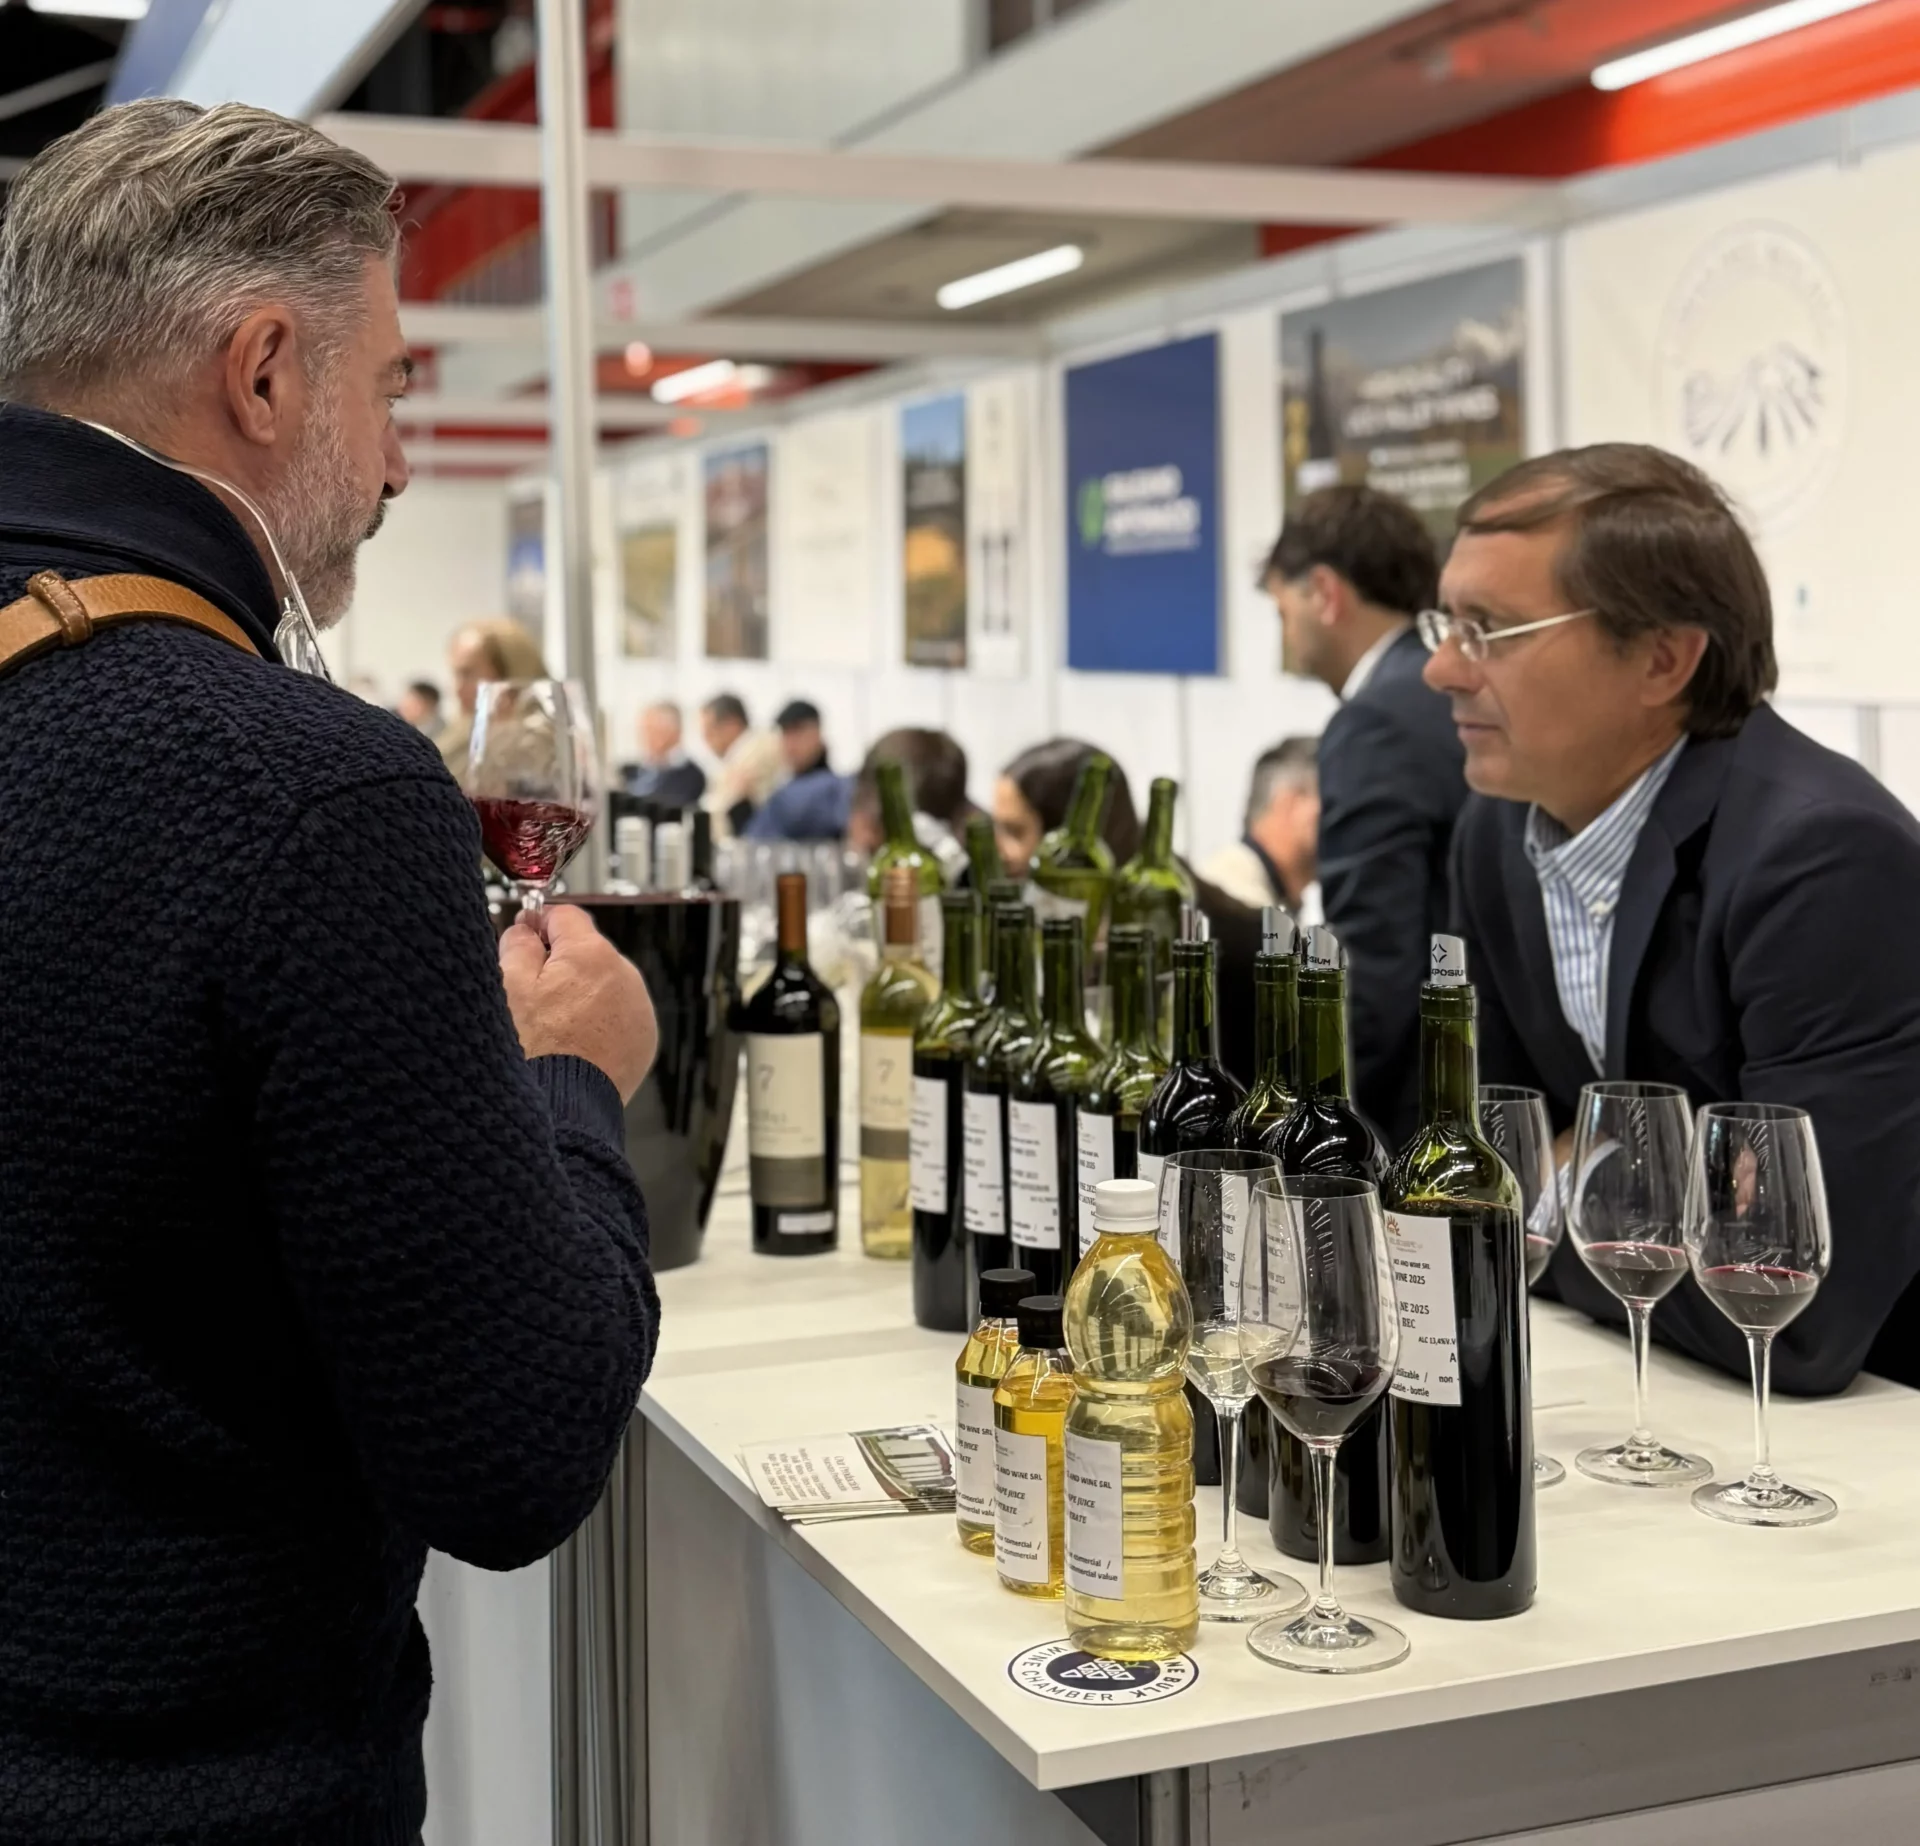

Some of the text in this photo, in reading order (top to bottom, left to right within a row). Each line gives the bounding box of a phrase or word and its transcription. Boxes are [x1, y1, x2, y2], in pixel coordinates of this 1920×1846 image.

[1408, 1273, 1426, 1285] 2025
[1410, 1302, 1430, 1315] 2025
[1401, 1316, 1416, 1329] BEC
[1449, 1352, 1457, 1363] A
[1438, 1375, 1454, 1384] non
[981, 1427, 993, 1436] SRL
[1011, 1470, 1029, 1480] WINE
[1030, 1472, 1043, 1481] SRL
[1080, 1476, 1098, 1488] WINE
[1099, 1480, 1113, 1490] SRL
[1007, 1489, 1026, 1500] JUICE
[1076, 1496, 1096, 1509] JUICE
[981, 1509, 995, 1517] valu
[1097, 1572, 1119, 1582] value
[1022, 1646, 1114, 1702] WINE CHAMBER
[1129, 1676, 1183, 1698] BULK
